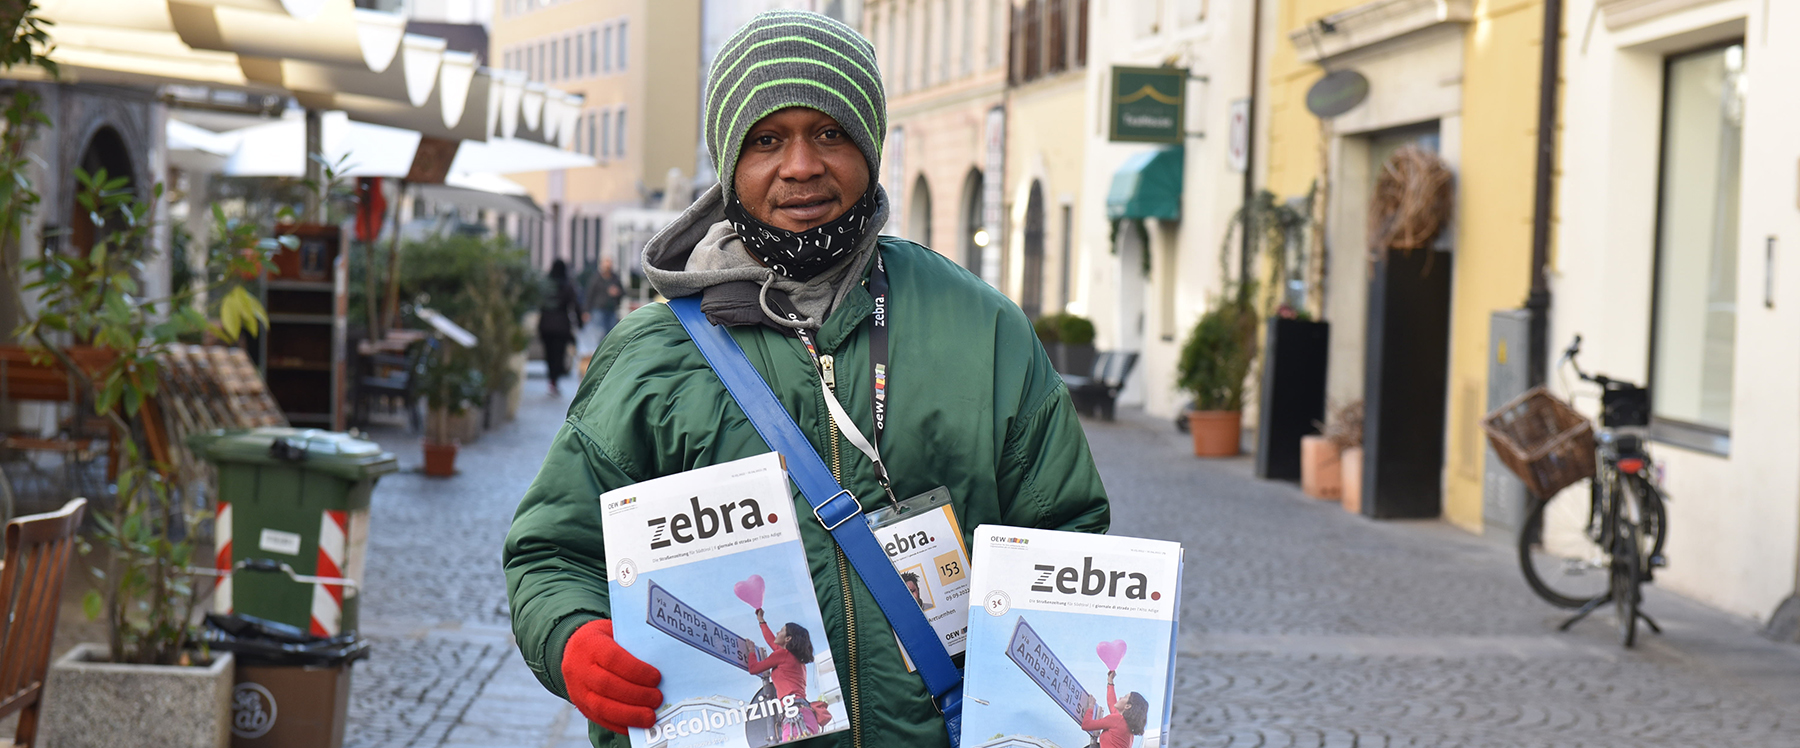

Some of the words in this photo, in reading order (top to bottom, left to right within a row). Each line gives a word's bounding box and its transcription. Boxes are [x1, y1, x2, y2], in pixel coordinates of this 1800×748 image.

[647, 495, 778, 550] zebra.
[884, 530, 935, 557] ebra.
[940, 561, 960, 577] 153
[1031, 557, 1161, 601] zebra.
[656, 597, 667, 608] via
[673, 603, 707, 631] Amba
[713, 627, 739, 649] Alagi
[946, 629, 960, 641] OEW
[1021, 632, 1030, 645] via
[1033, 643, 1060, 674] Amba
[1062, 676, 1083, 701] Alagi
[645, 694, 798, 744] Decolonizing
